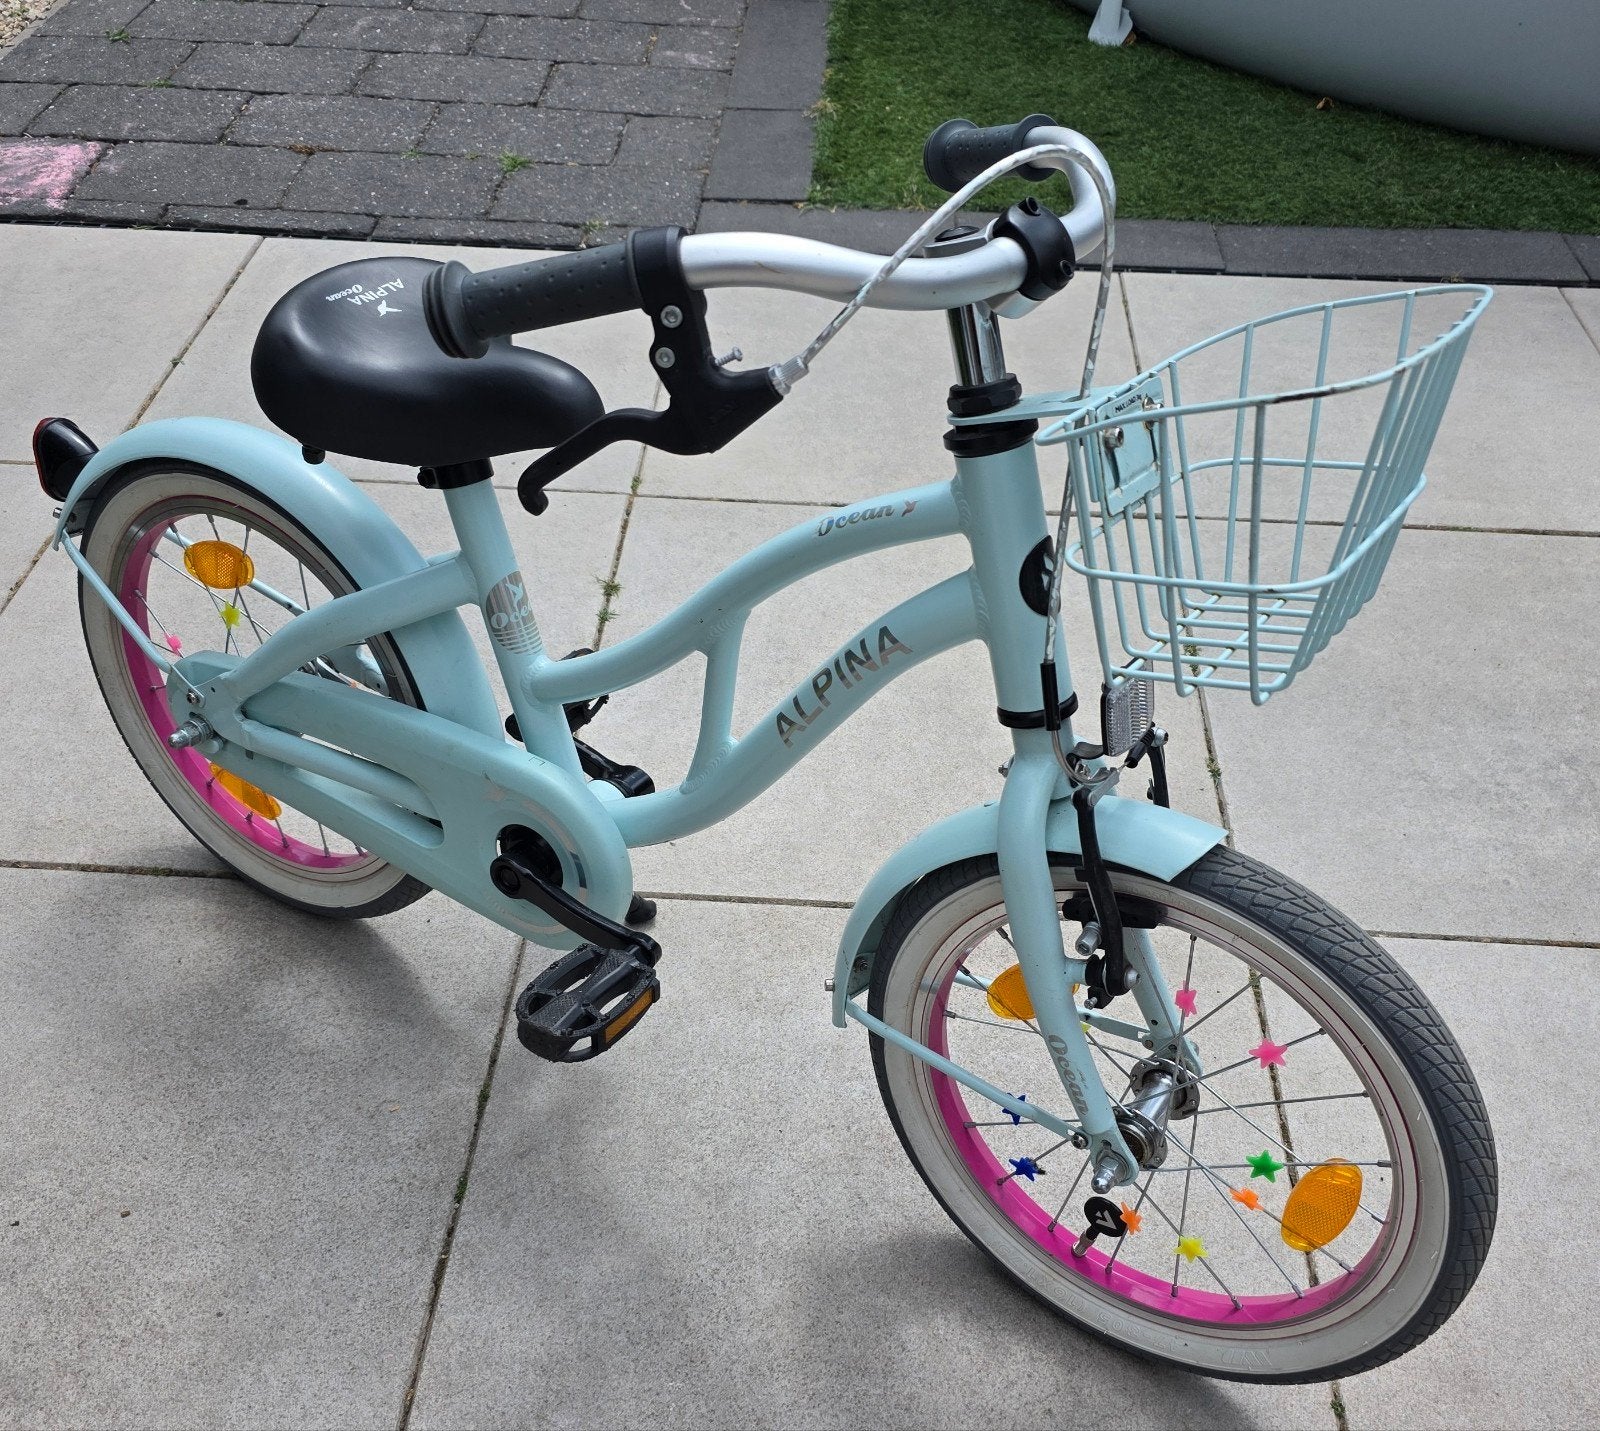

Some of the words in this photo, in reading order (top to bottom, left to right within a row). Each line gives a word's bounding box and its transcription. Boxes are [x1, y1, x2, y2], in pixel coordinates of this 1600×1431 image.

[325, 284, 363, 302] Ocean
[346, 278, 404, 306] ALPINA
[816, 504, 896, 537] Ocean
[776, 625, 914, 748] ALPINA
[1047, 1034, 1089, 1116] Ocean
